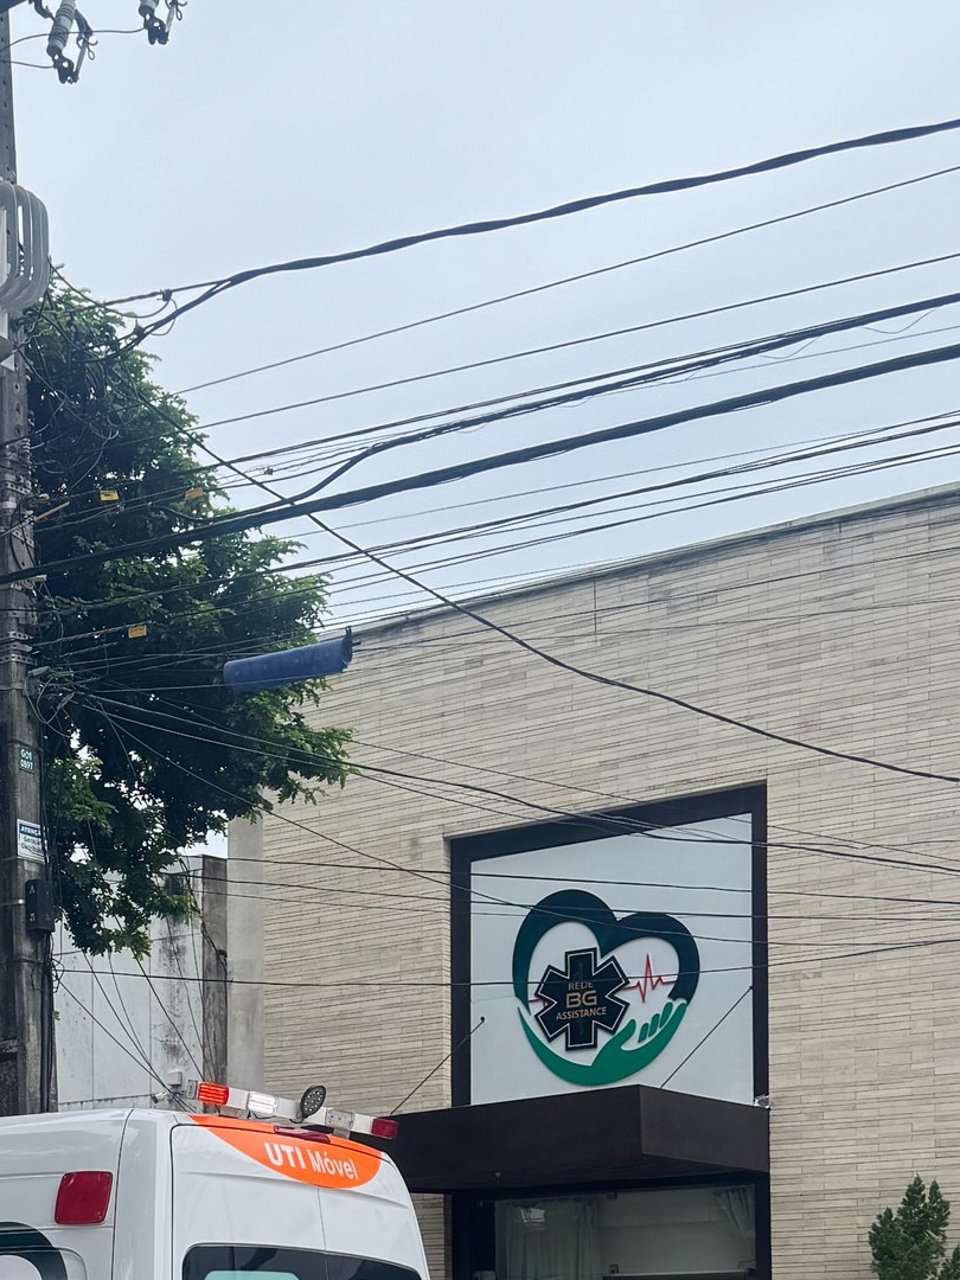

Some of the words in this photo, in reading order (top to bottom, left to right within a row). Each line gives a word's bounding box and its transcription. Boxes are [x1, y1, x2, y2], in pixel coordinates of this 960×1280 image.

[568, 981, 594, 991] REDE
[566, 990, 597, 1008] BG
[556, 1006, 607, 1020] ASSISTANCE
[264, 1142, 307, 1169] UTI
[307, 1148, 359, 1180] Móvel
